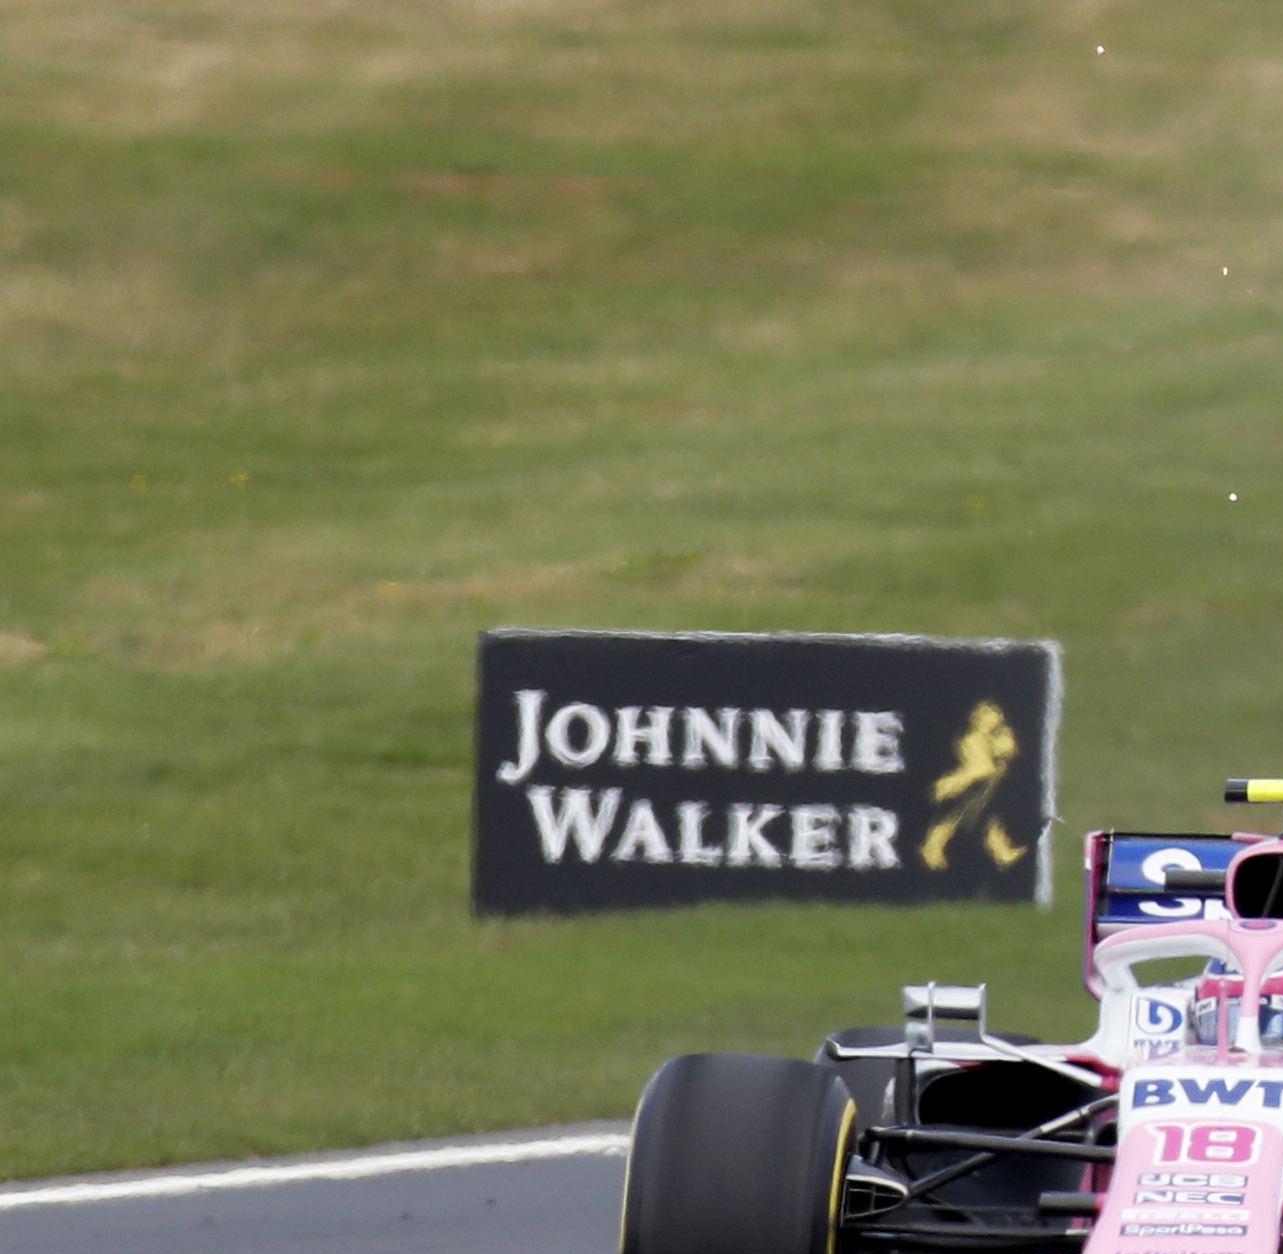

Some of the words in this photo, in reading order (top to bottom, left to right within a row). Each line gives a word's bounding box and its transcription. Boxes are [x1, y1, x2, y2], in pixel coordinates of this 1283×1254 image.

[496, 689, 905, 785] JOHNNIE
[526, 785, 902, 869] WALKER
[1146, 1123, 1260, 1165] 18
[1135, 1190, 1244, 1205] NEC
[1139, 1173, 1248, 1188] JCB
